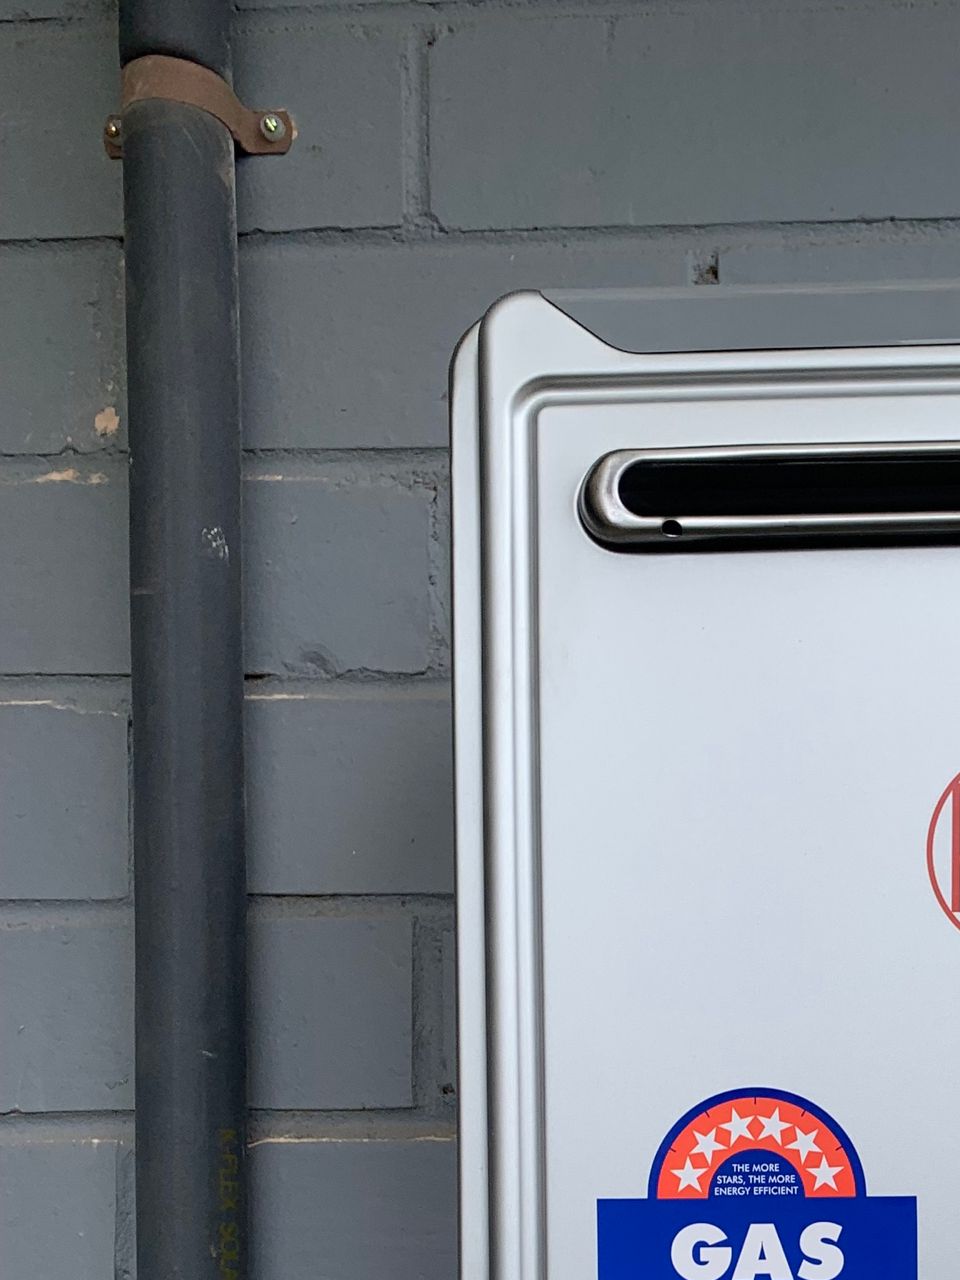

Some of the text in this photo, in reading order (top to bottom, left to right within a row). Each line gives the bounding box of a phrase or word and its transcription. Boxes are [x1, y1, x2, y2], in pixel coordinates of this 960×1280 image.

[732, 1162, 780, 1172] THE MORE
[717, 1174, 795, 1184] STARS, THE MORE
[714, 1185, 798, 1195] ENERGY EFFICIENT
